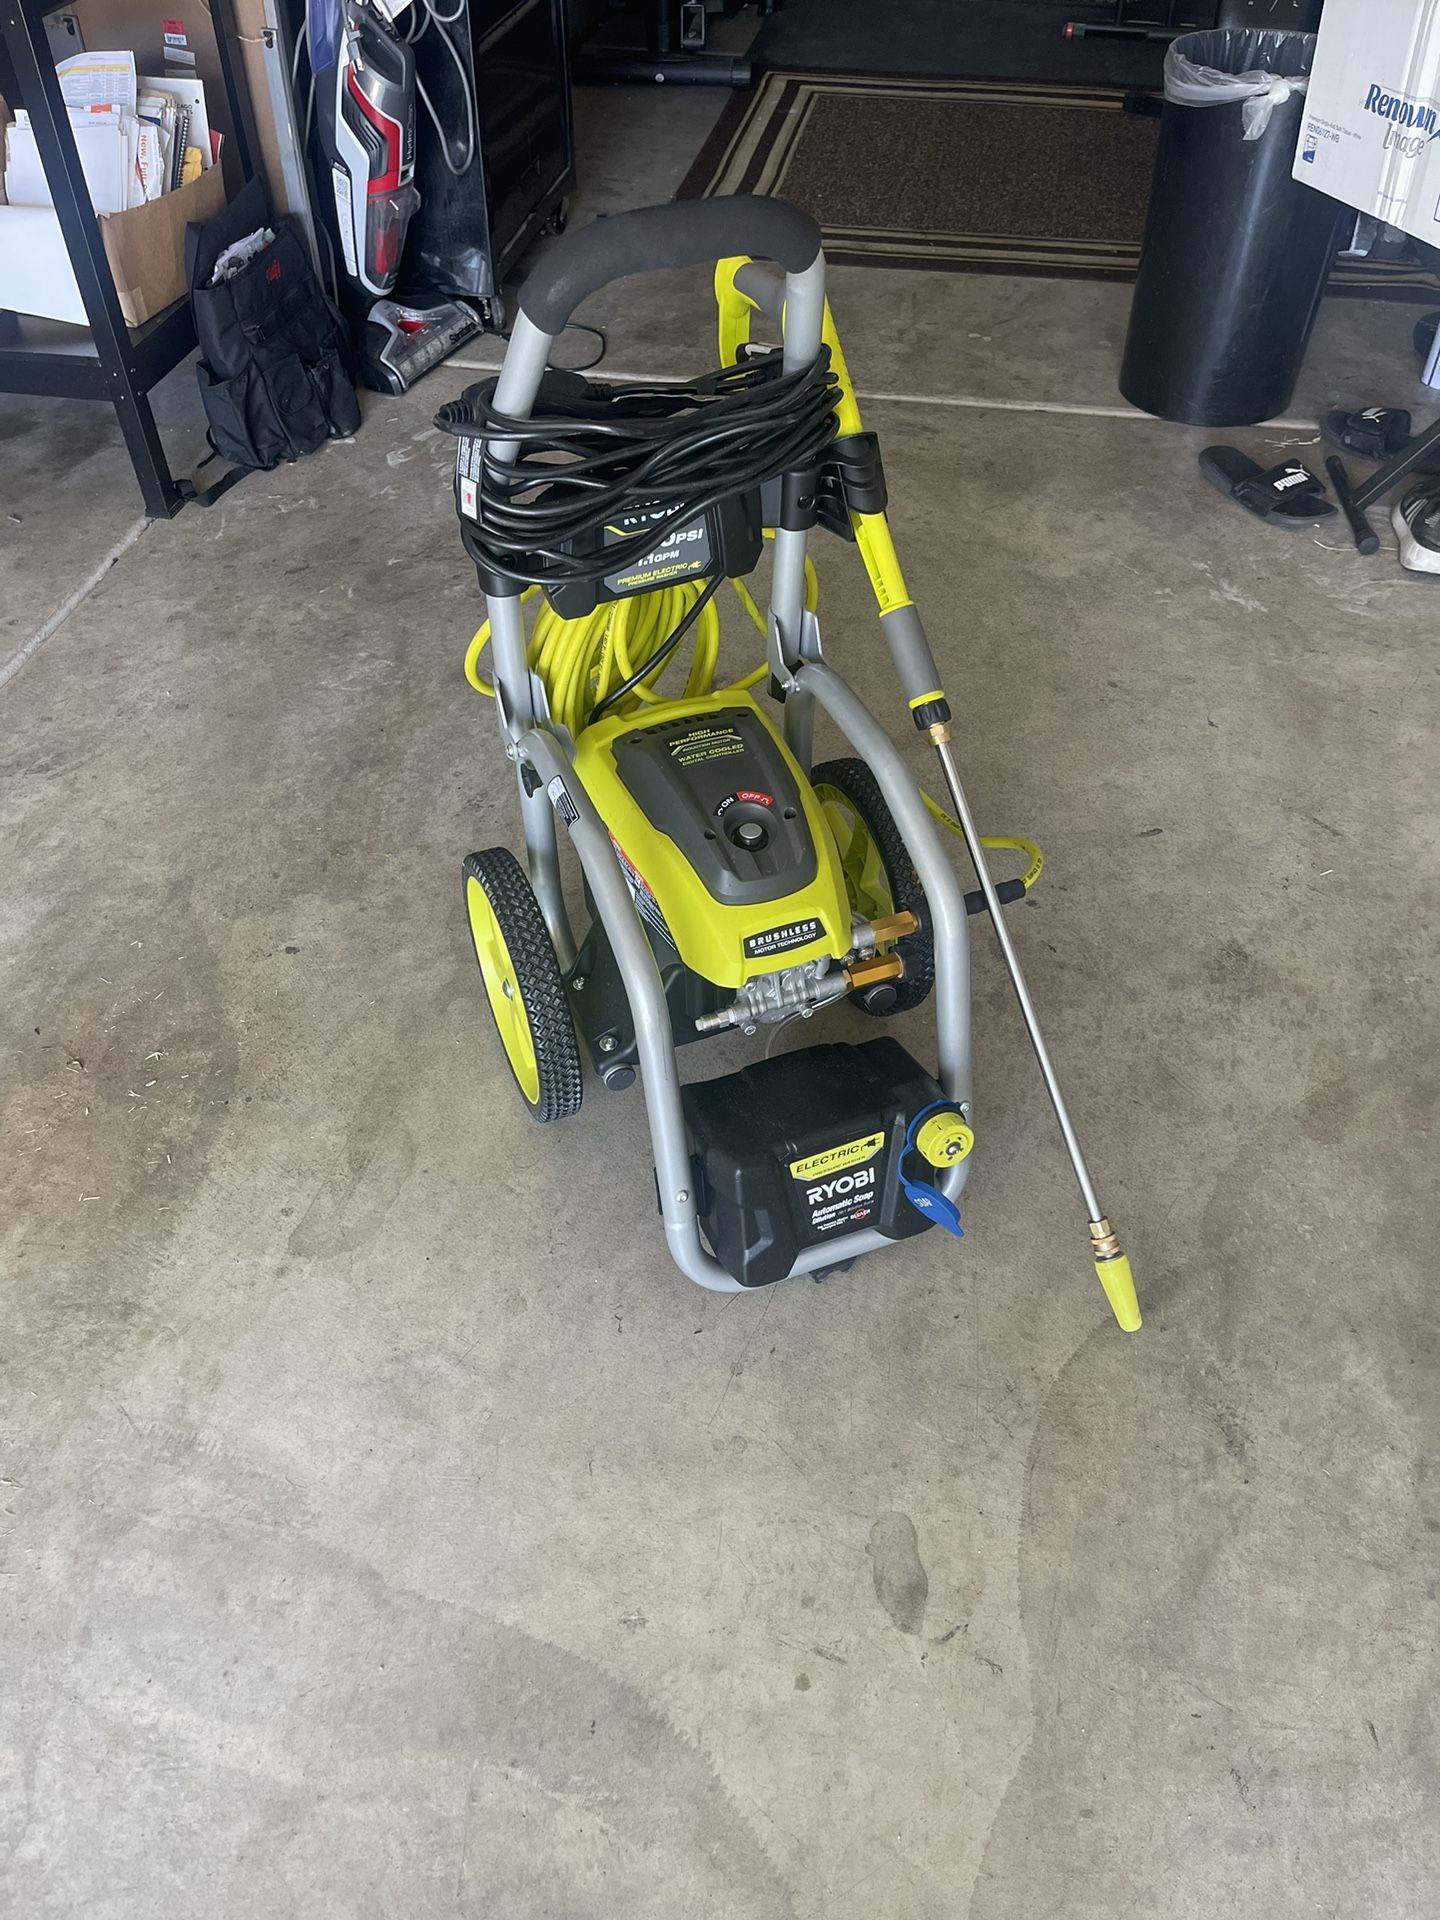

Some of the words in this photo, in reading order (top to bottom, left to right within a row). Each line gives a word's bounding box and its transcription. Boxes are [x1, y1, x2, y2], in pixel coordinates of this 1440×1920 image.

[1364, 84, 1437, 134] Renown
[1382, 122, 1424, 158] Image
[1273, 472, 1309, 491] PUMA
[616, 572, 652, 586] PREMIUM
[652, 562, 688, 575] ELECTRIC
[669, 728, 734, 747] PERFORMANCE
[688, 728, 710, 737] HIGH
[678, 751, 707, 763] WATER
[708, 743, 744, 755] COOLED
[721, 796, 735, 808] ON
[749, 921, 817, 948] BRUSHLESS
[754, 943, 777, 955] MOTOR
[777, 932, 817, 948] TECHNOLOGY
[796, 1145, 859, 1173] ELECTRIC
[806, 1167, 875, 1205] RYOBI
[811, 1198, 853, 1219] Automatic
[853, 1191, 874, 1204] Soap
